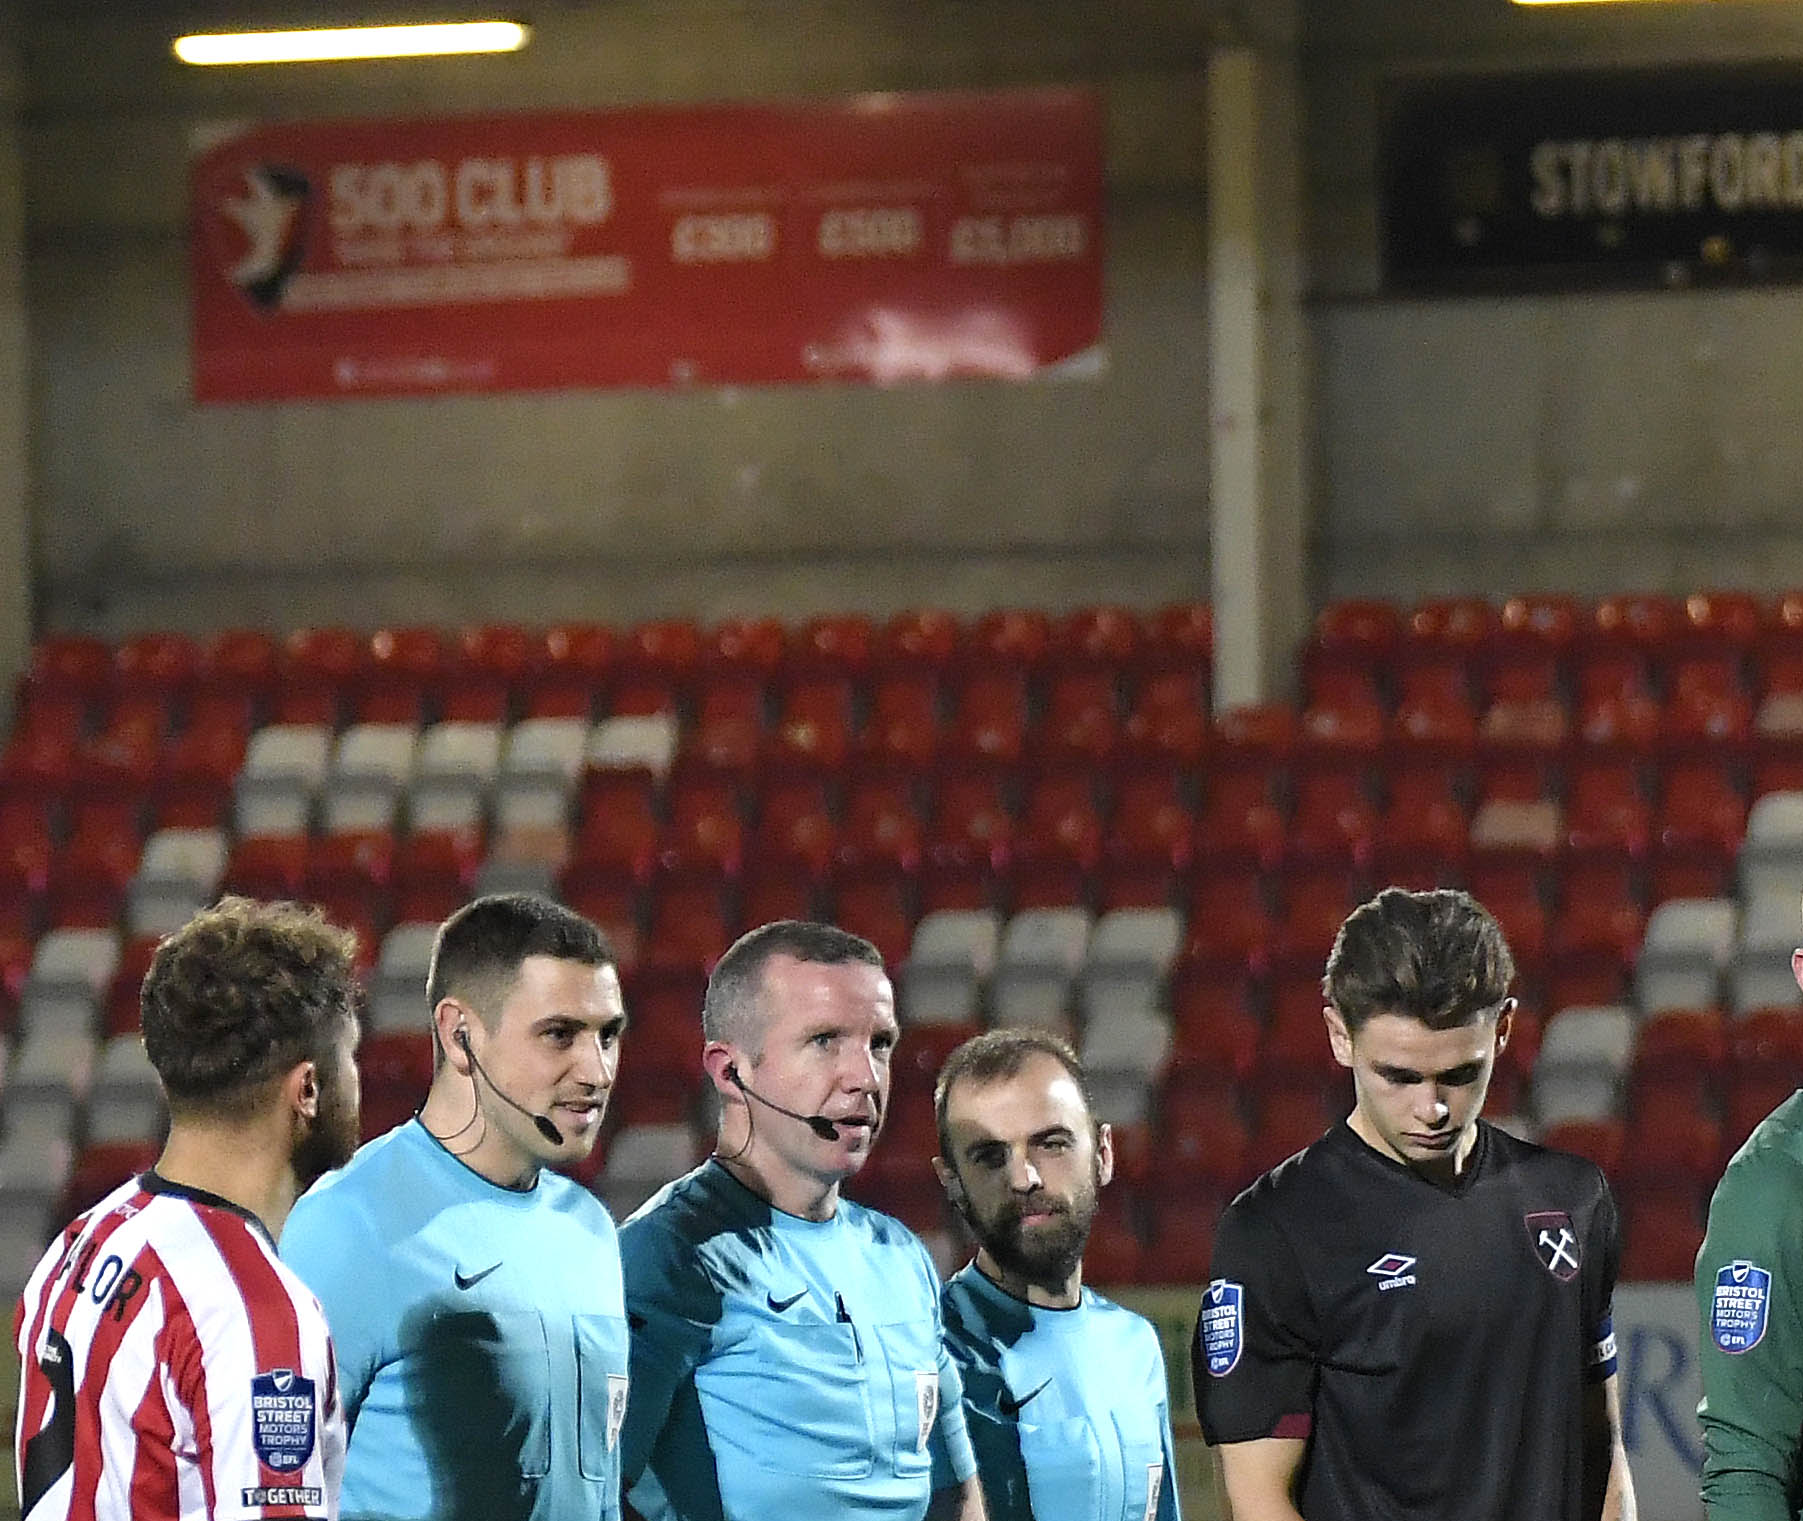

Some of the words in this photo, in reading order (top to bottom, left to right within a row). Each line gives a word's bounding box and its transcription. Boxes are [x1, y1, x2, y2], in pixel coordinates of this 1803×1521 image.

[330, 160, 448, 228] 500
[457, 153, 612, 226] CLUB
[1378, 1275, 1417, 1291] umbro
[1716, 1285, 1765, 1300] BRISTOL
[1715, 1297, 1762, 1311] STREET
[1716, 1309, 1758, 1320] MOTORS
[1716, 1318, 1757, 1329] TROPHY
[253, 1396, 313, 1410] BRISTOL
[256, 1410, 311, 1423] STREET
[259, 1424, 308, 1434] MOTORS
[260, 1435, 307, 1446] TROPHY
